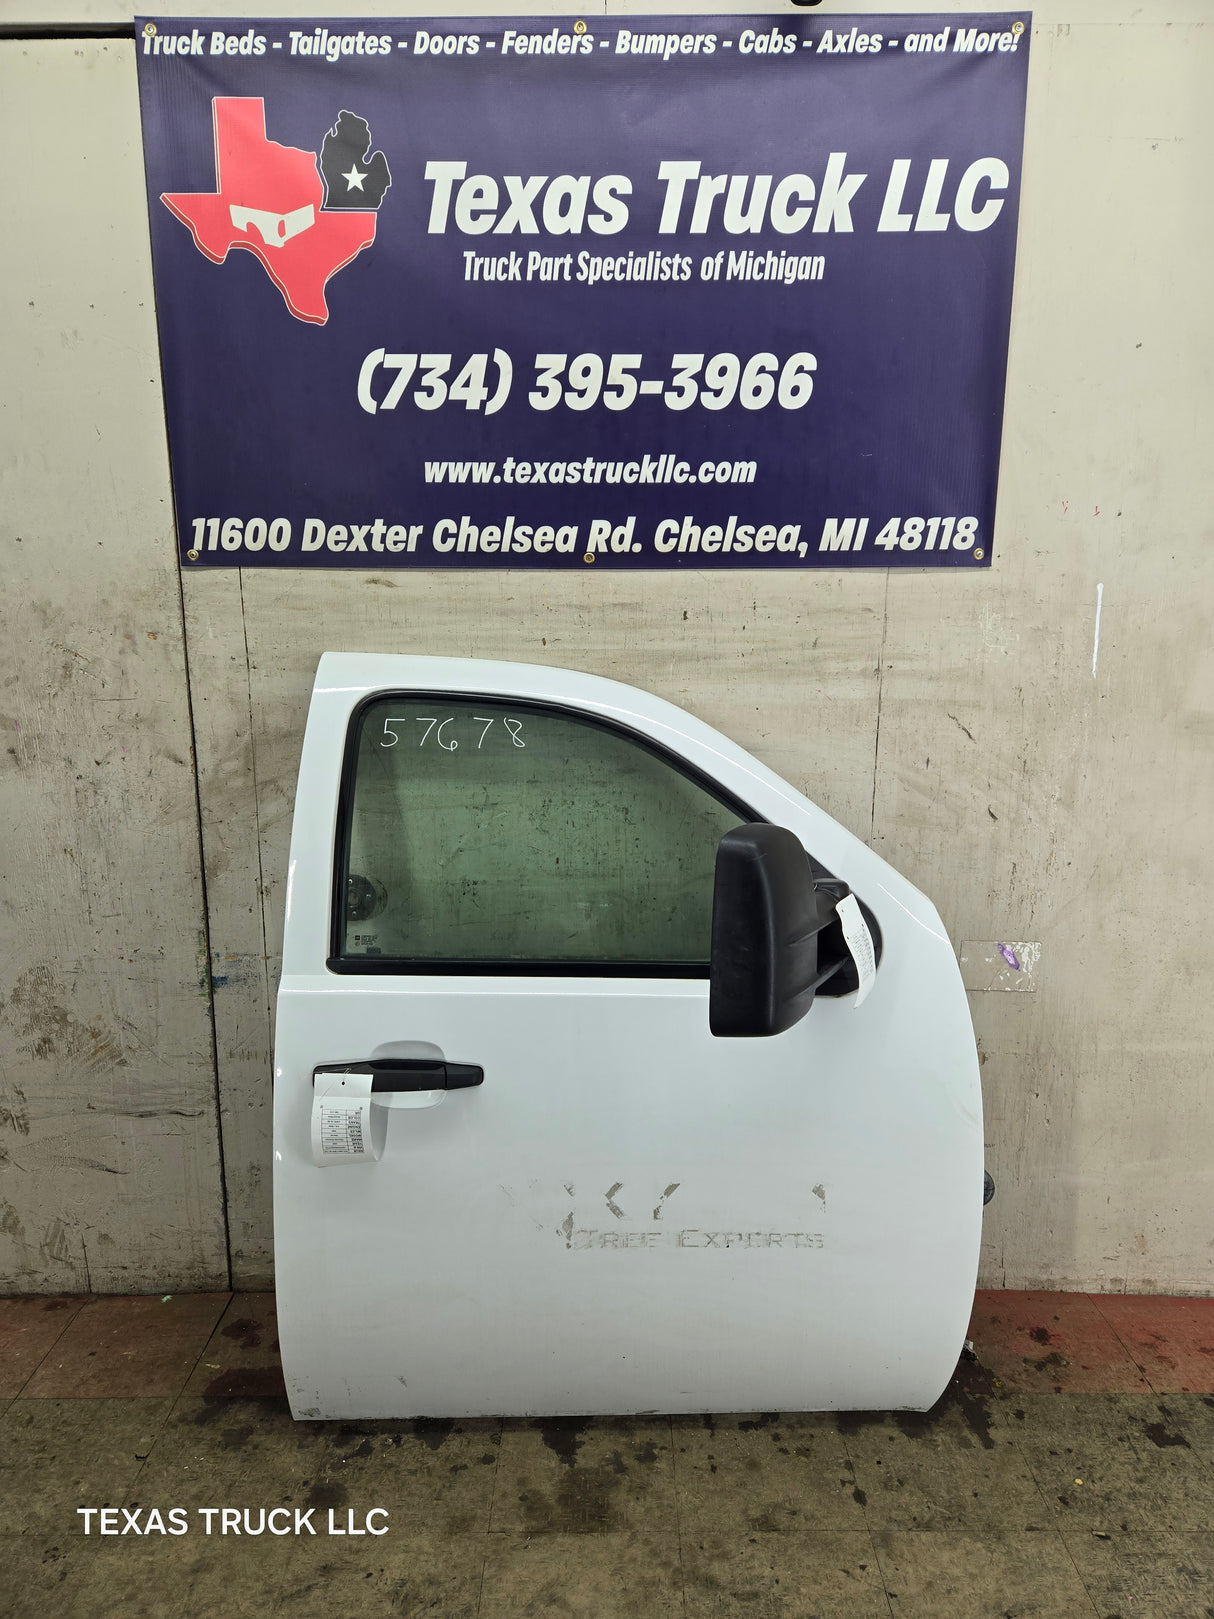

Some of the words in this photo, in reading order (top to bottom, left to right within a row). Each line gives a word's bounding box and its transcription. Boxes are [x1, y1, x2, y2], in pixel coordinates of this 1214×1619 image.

[141, 29, 206, 55] Truck
[209, 29, 267, 56] Beds
[289, 28, 393, 62] Tailgates
[413, 30, 481, 55] Doors
[501, 28, 595, 55] Fenders
[614, 29, 718, 61] Bumpers
[738, 27, 798, 54] Cabs
[816, 27, 884, 53] Axles
[903, 26, 951, 53] and
[952, 28, 1020, 53] More!
[423, 160, 633, 235] Texas
[657, 151, 868, 235] Truck
[876, 157, 1010, 233] LLC
[463, 250, 522, 281] Truck
[526, 251, 574, 281] Part
[576, 250, 693, 285] Specialists
[700, 250, 725, 281] of
[726, 250, 826, 285] Michigan
[357, 347, 513, 416] (734)
[528, 352, 818, 411] 395-3966
[424, 454, 757, 484] www.texastruckllc.com
[191, 517, 292, 551] 11600
[301, 518, 424, 552] Dexter
[432, 515, 579, 553] Chelsea
[586, 516, 642, 553] Rd.
[654, 515, 809, 558] Chelsea,
[818, 517, 870, 551] MI
[874, 516, 979, 551] 48118
